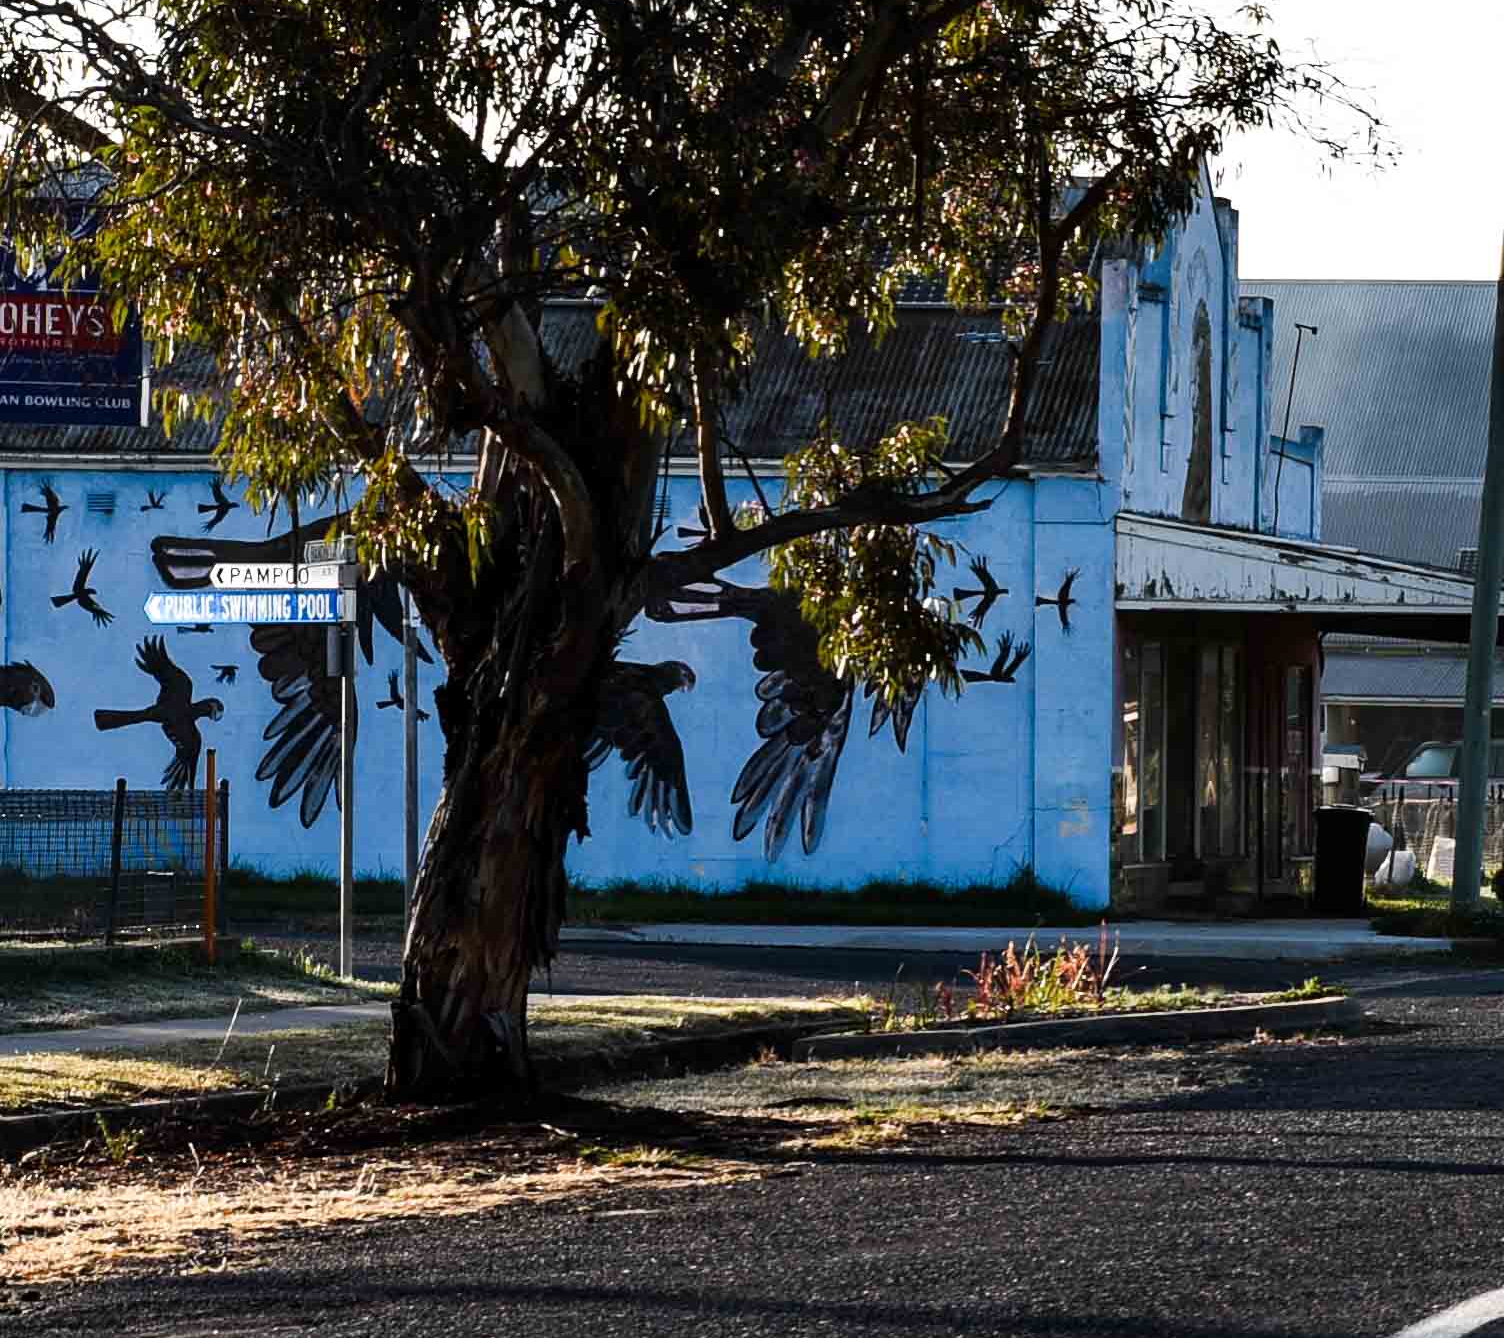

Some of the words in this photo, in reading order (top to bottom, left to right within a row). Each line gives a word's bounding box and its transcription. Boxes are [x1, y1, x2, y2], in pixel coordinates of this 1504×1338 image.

[25, 395, 91, 408] BOWLING
[96, 396, 131, 409] CLUB
[165, 594, 215, 619] PUBLIC
[221, 594, 291, 620] SWIMMING
[297, 594, 333, 618] POOL
